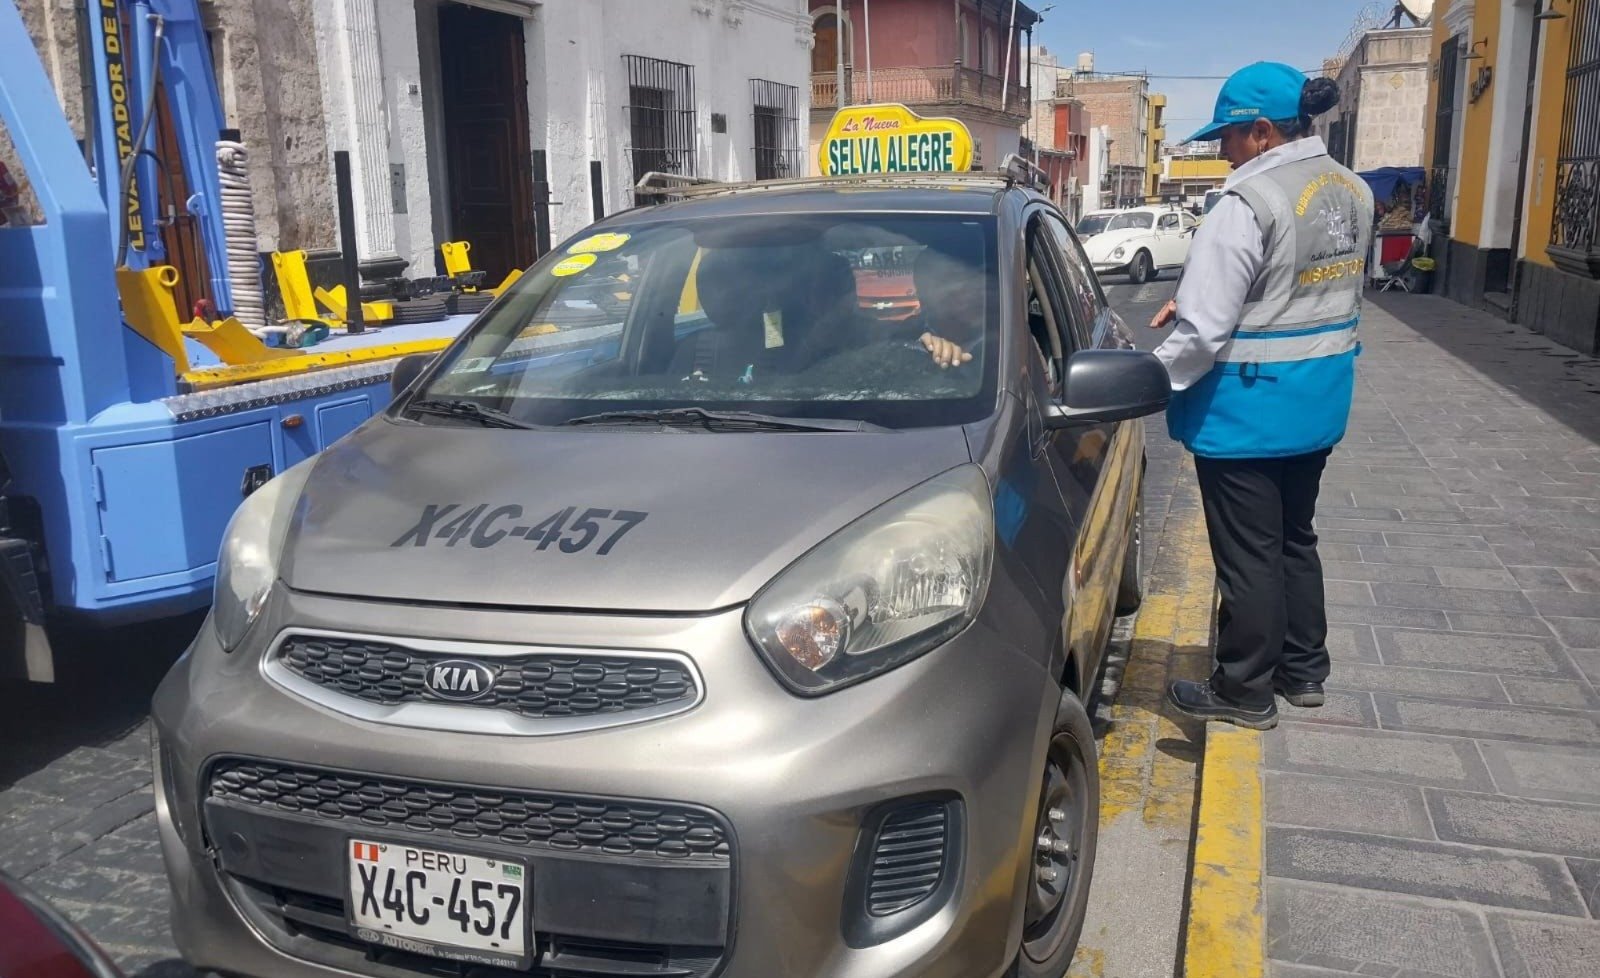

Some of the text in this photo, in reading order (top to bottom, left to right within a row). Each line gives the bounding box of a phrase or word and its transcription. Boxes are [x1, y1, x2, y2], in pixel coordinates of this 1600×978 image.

[103, 16, 120, 54] DE
[842, 116, 900, 132] La Nueva
[110, 63, 145, 247] LEVATADOR
[829, 132, 953, 176] SELVA ALEGRE
[390, 503, 649, 556] X4C-457
[433, 667, 480, 692] KIA
[405, 850, 467, 875] PERU
[357, 863, 521, 940] X4C-457
